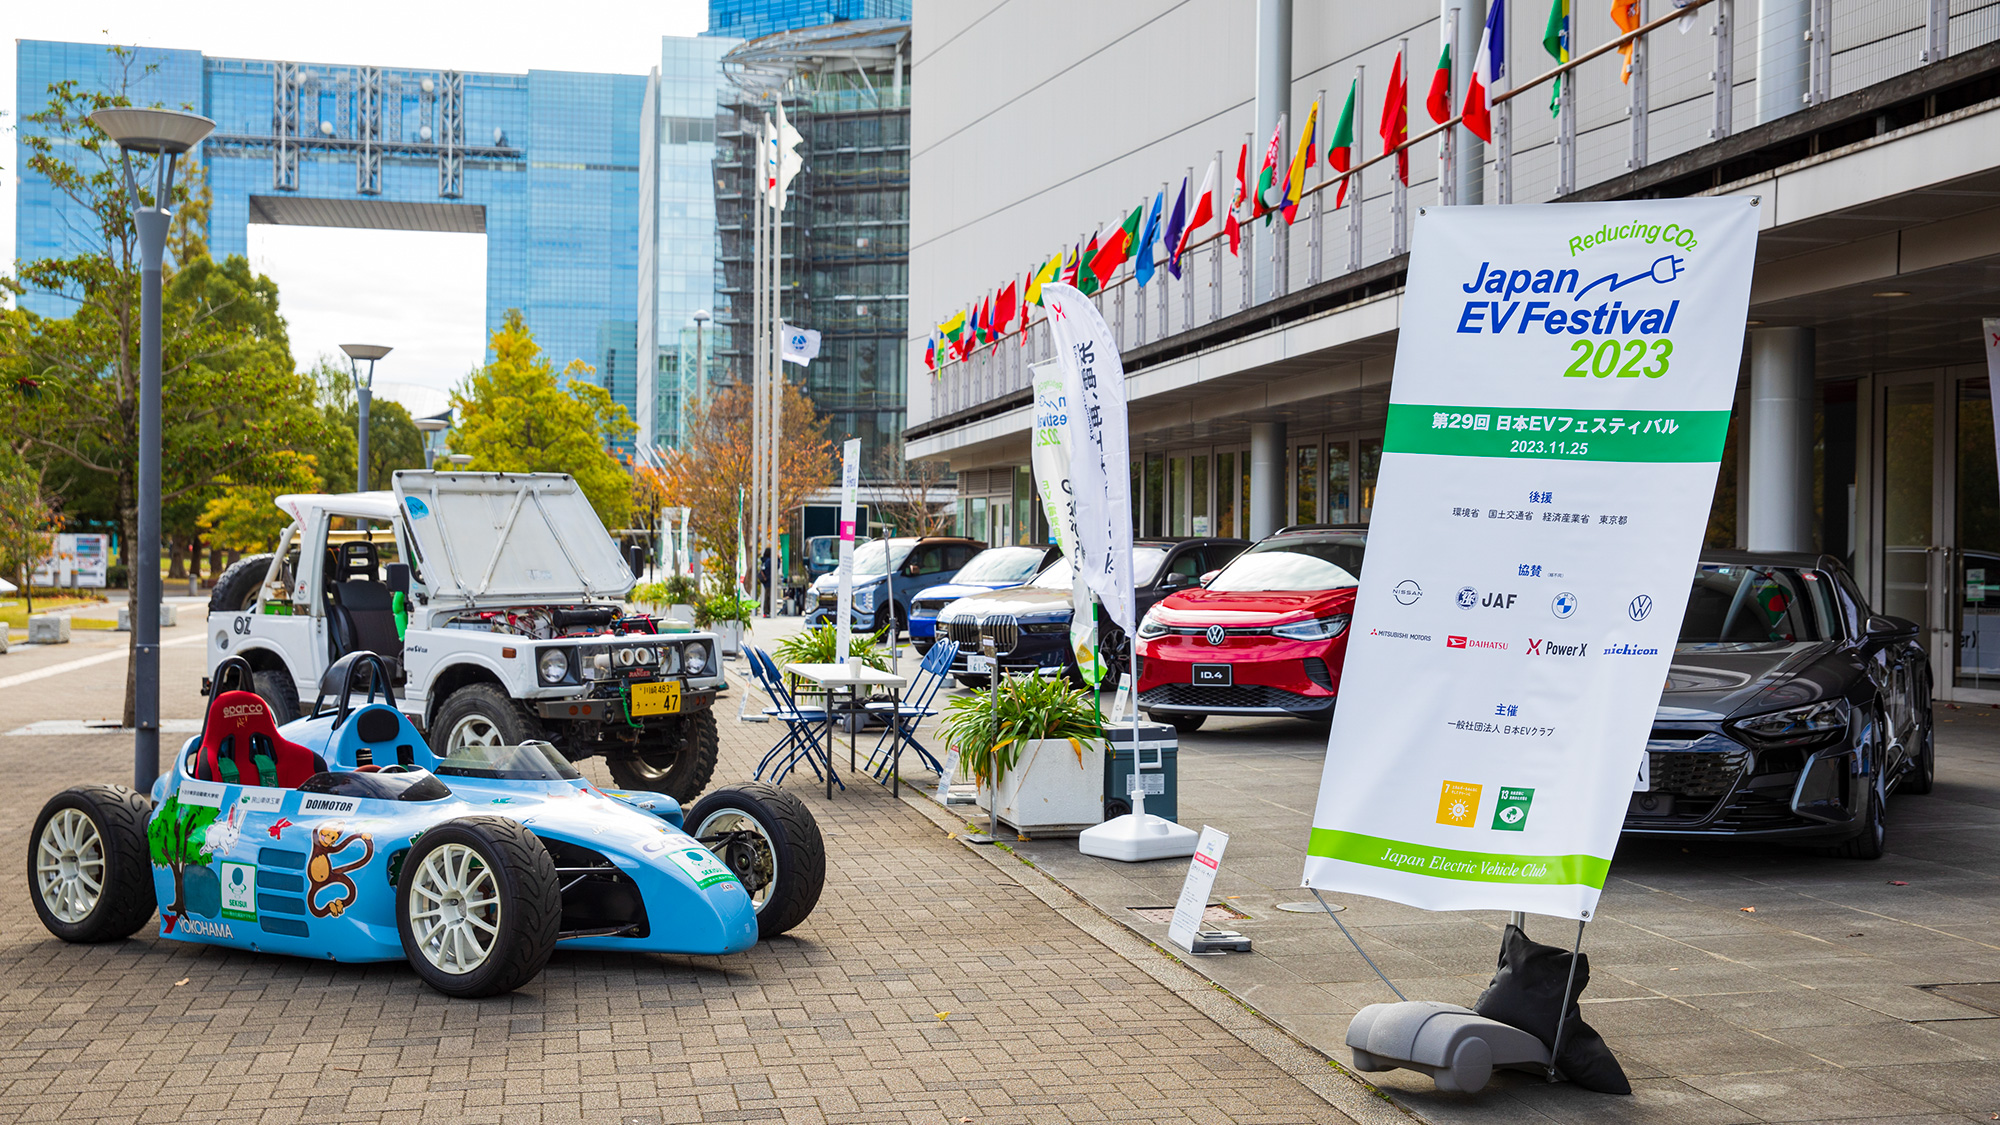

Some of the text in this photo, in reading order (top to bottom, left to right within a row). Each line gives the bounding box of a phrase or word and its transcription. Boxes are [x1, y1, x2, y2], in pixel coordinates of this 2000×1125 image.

[1568, 219, 1661, 257] Reducing
[1462, 262, 1580, 302] Japan
[1456, 300, 1681, 335] EV Festival
[1563, 338, 1674, 379] 2023
[1432, 412, 1680, 435] 第29回 日本EVフェスティバル
[1510, 440, 1589, 455] 2023.11.25
[1528, 491, 1553, 504] 後援
[1452, 507, 1628, 526] 環境省 国土交通省 経済産業省 東京都
[1518, 563, 1542, 578] 協賛
[1392, 588, 1423, 597] NISSAN
[1481, 592, 1518, 609] JAF
[233, 616, 251, 635] OZ
[1378, 630, 1432, 642] MITSUBISHI MOTORS
[1469, 639, 1509, 650] DAIHATSU
[1603, 643, 1659, 656] nichicon
[1494, 703, 1519, 718] 主催
[1447, 720, 1555, 737] 一般社団法人 日本EVクラブ
[1445, 784, 1450, 793] 7
[1501, 790, 1509, 800] 13
[305, 799, 354, 812] DOIMOTOR
[1380, 847, 1548, 878] Japan Electric Vehicle Club
[229, 899, 247, 908] SEKISUI
[178, 918, 234, 940] YOKOHAMA
